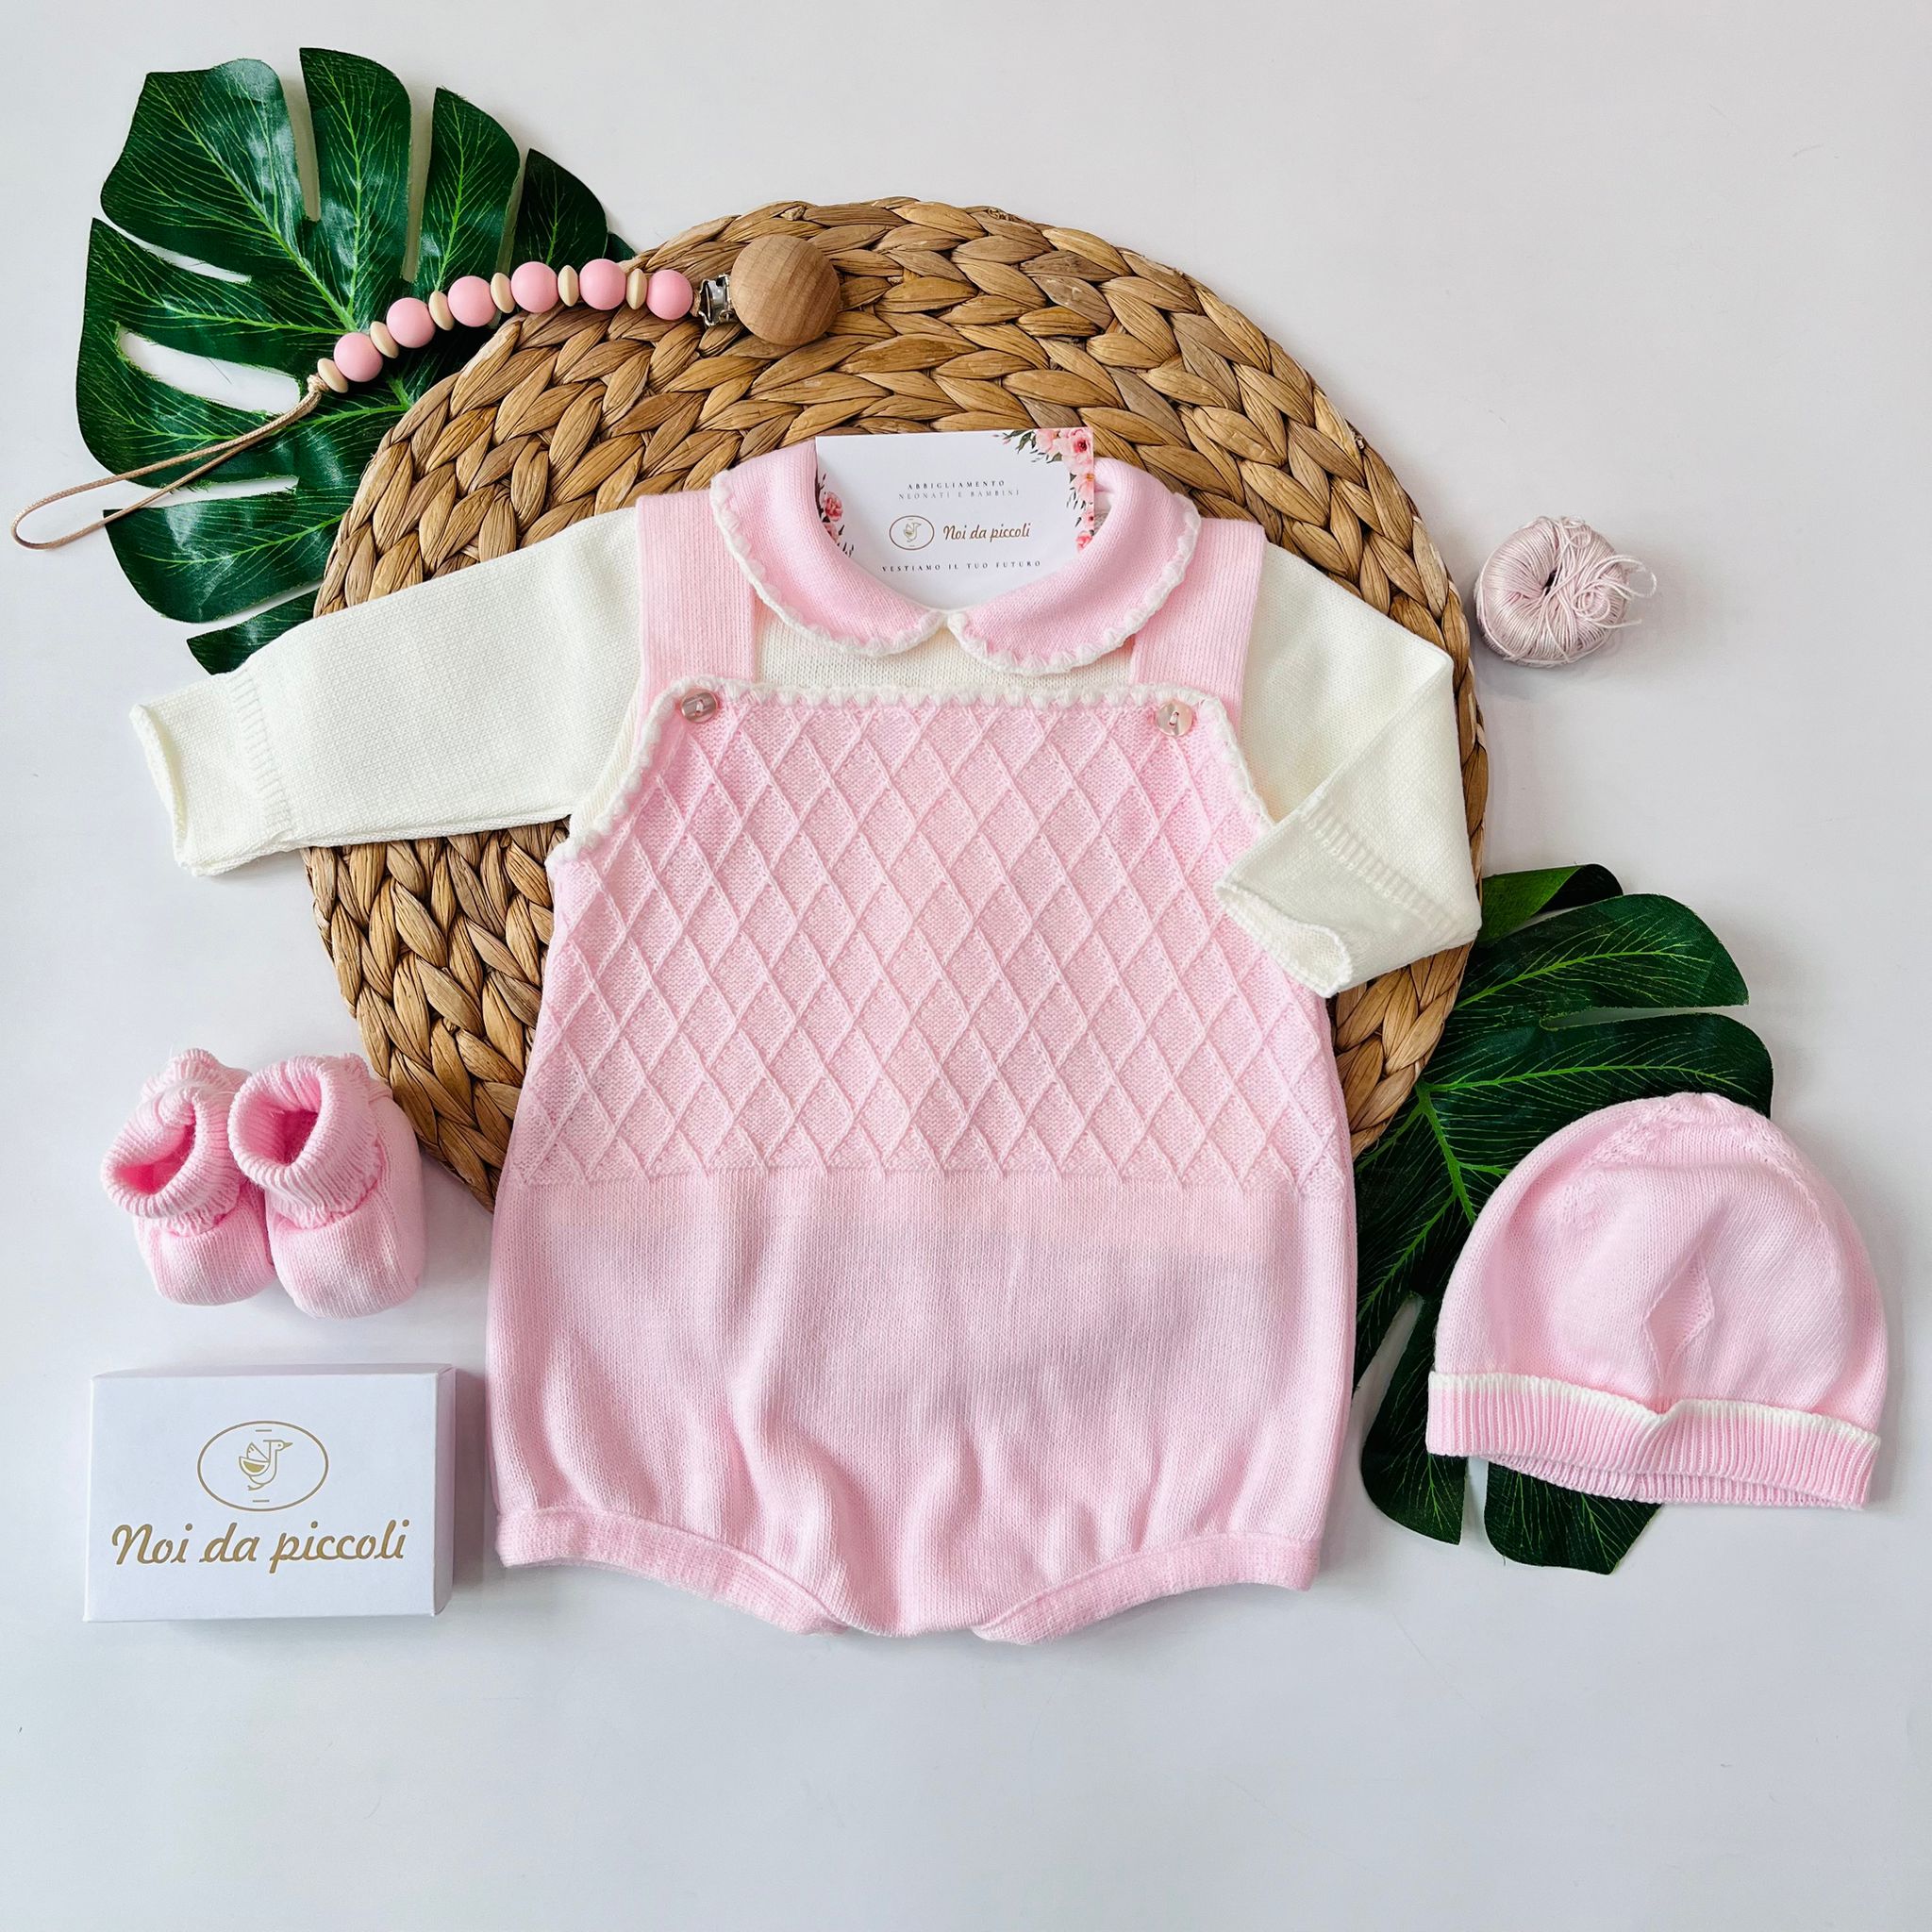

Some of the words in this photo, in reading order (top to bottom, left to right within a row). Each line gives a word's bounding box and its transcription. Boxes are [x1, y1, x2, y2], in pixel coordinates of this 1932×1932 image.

[908, 480, 1005, 490] ABBIGLIAMENTO
[898, 491, 951, 501] NEONATI
[970, 489, 1020, 498] BAMBINI
[942, 525, 968, 541] Noi
[969, 524, 987, 541] da
[990, 522, 1032, 543] piccoli
[881, 563, 941, 573] VESTIAMO
[110, 1522, 194, 1566] Noi
[198, 1521, 261, 1564] da
[268, 1518, 411, 1574] piccoli
